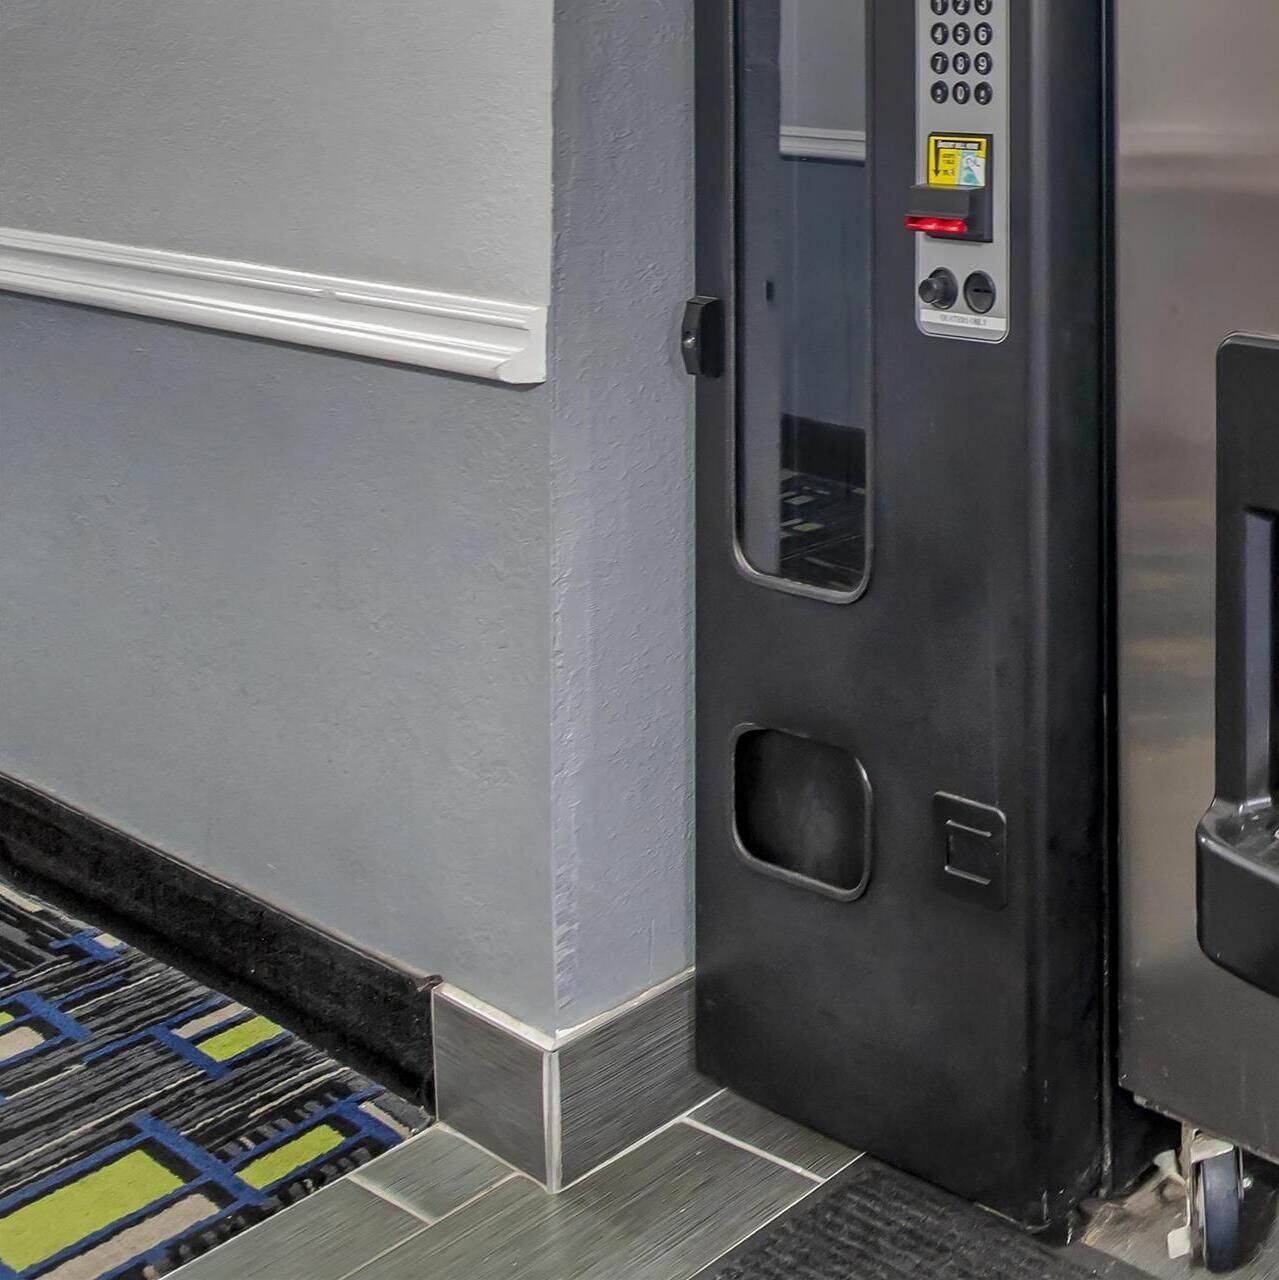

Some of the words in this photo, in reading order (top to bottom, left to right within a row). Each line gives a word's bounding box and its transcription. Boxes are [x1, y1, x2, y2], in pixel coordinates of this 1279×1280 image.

[934, 26, 943, 42] 4
[956, 26, 965, 42] 5
[978, 26, 987, 41] 6
[935, 56, 943, 71] 7
[957, 57, 965, 72] 8
[978, 56, 987, 71] 9
[956, 85, 965, 100] 0
